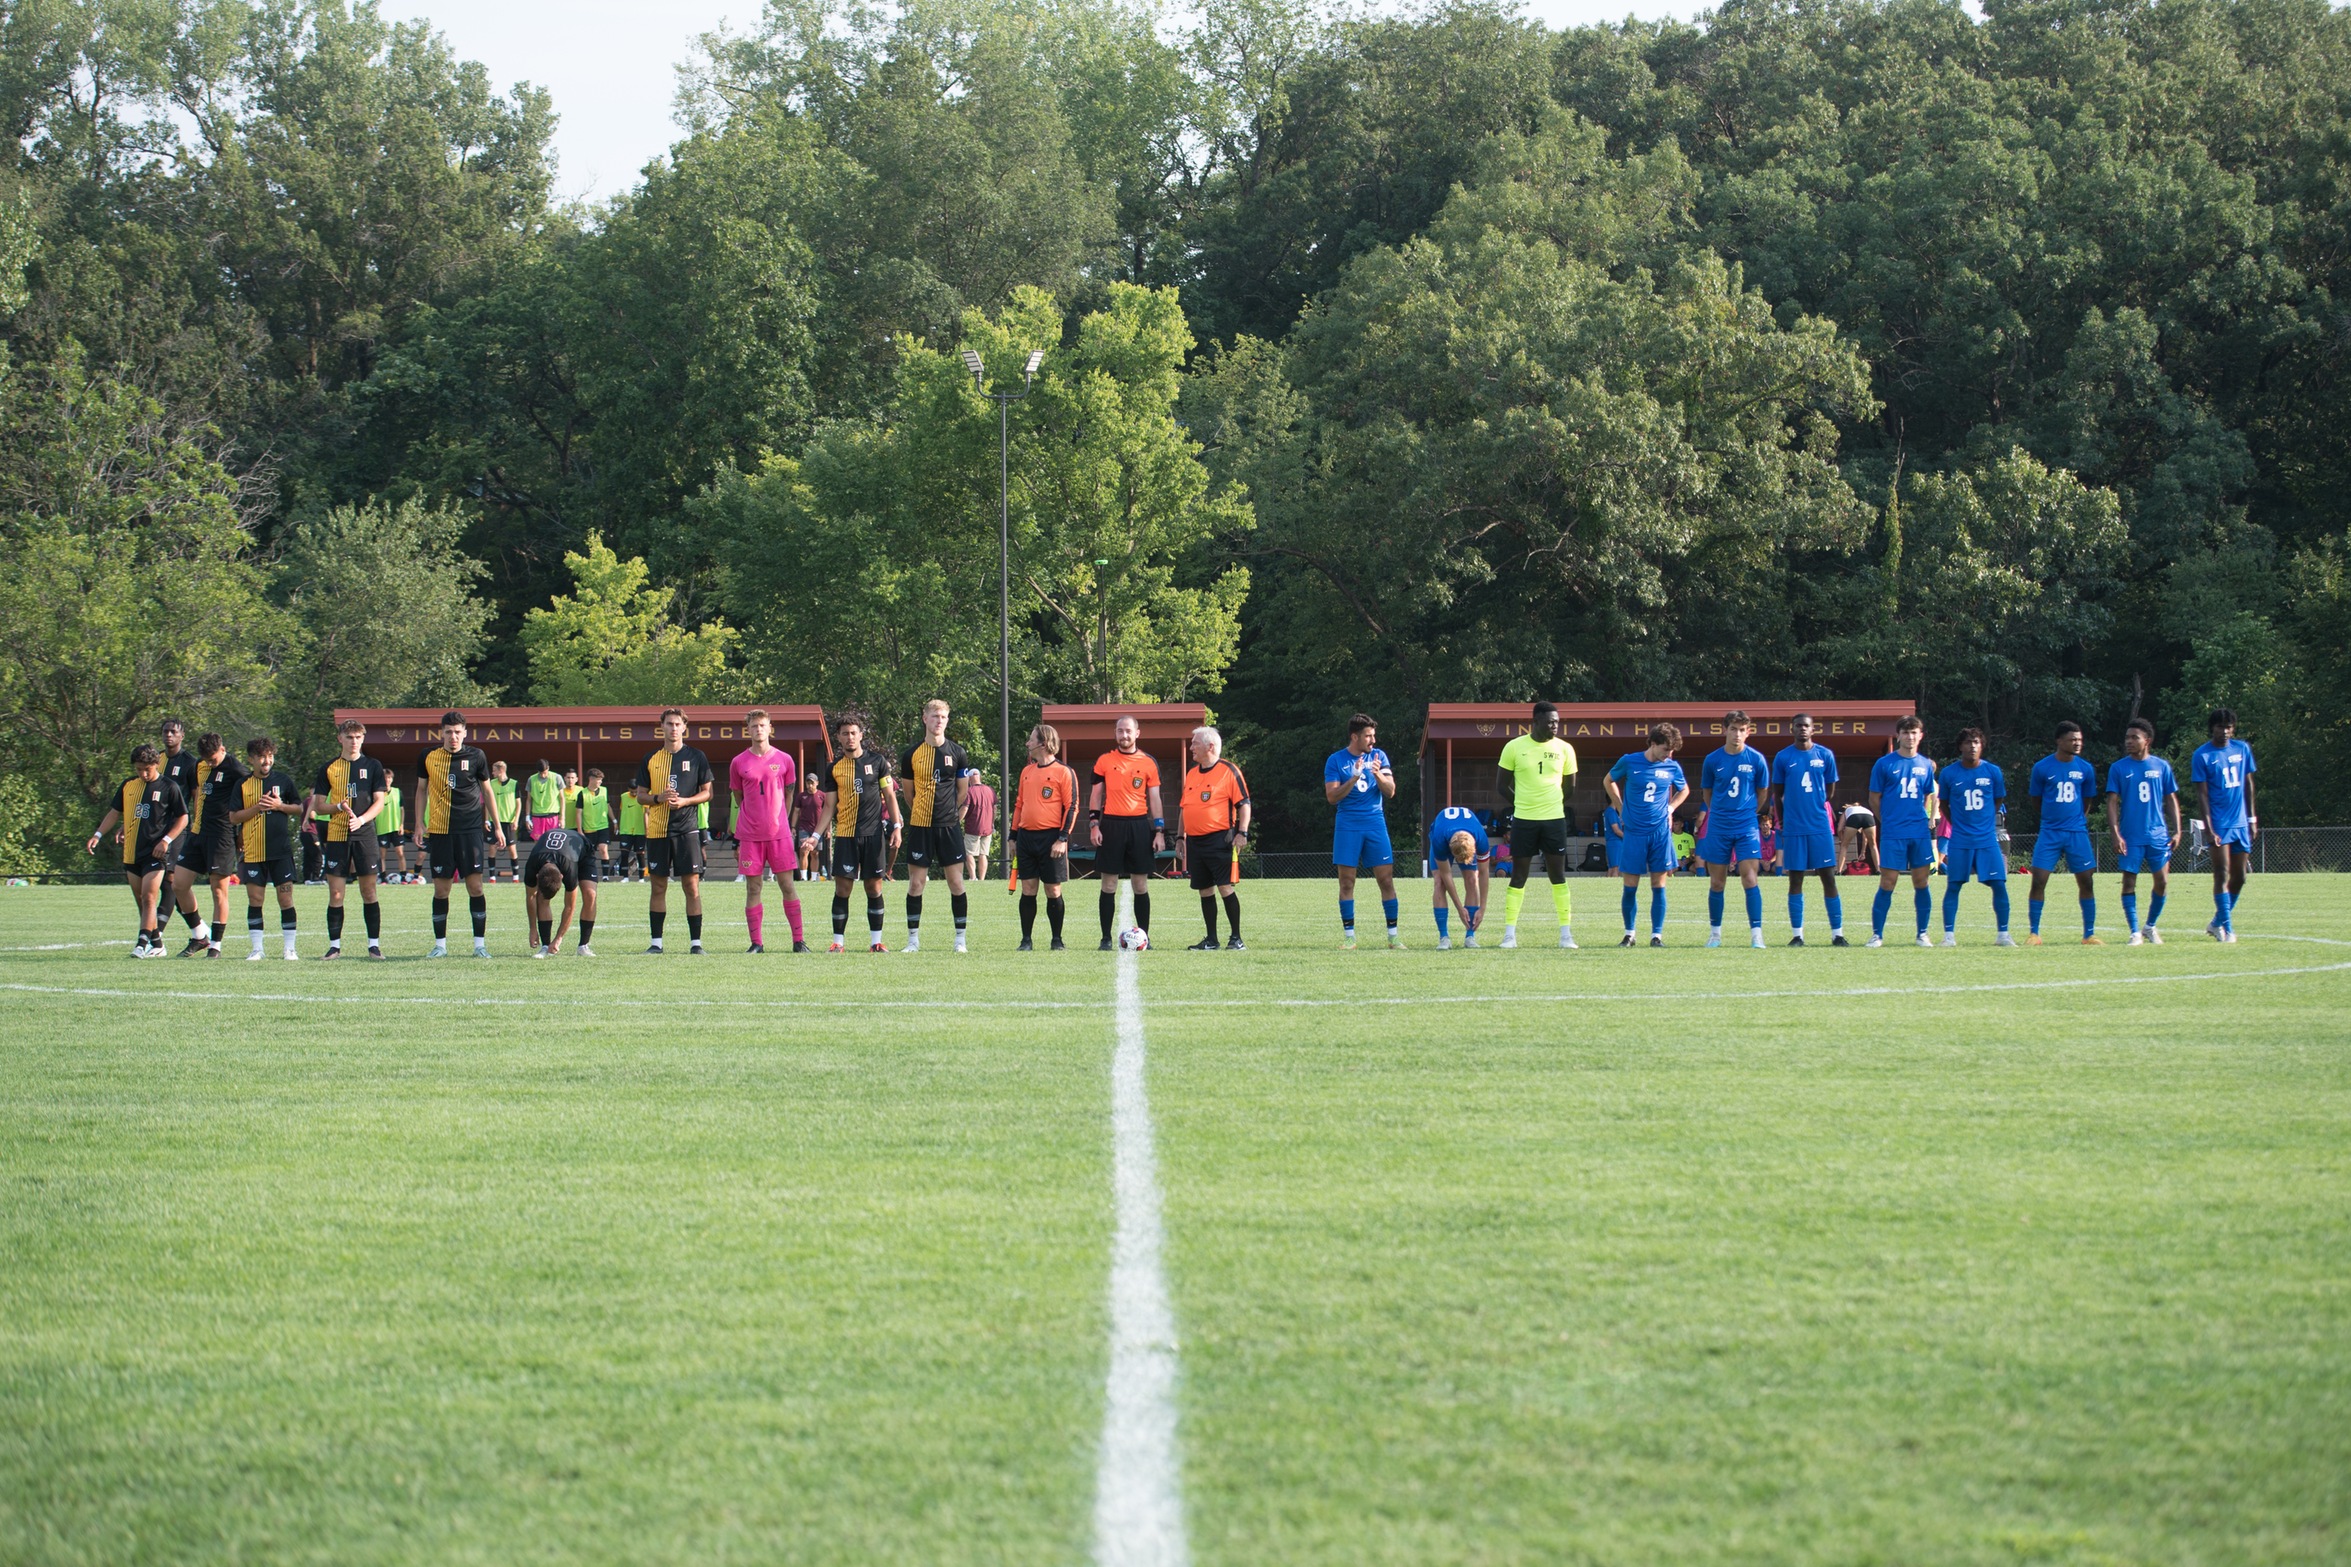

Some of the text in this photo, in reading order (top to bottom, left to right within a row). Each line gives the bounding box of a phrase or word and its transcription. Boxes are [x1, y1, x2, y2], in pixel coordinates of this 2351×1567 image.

[416, 728, 523, 740] INIAN
[544, 728, 632, 740] HILLS
[1506, 722, 1866, 736] INIAN HLS SOCER
[932, 768, 940, 784] 4
[1538, 761, 1543, 774] 1
[2222, 766, 2240, 788] 11
[347, 782, 358, 798] 11
[448, 773, 456, 790] 9
[760, 781, 764, 796] 1
[854, 778, 864, 794] 2
[1356, 772, 1368, 792] 6
[1728, 776, 1740, 798] 3
[1801, 771, 1812, 793] 4
[1900, 776, 1918, 799] 14
[1644, 782, 1656, 802] 2
[1964, 789, 1984, 811] 16
[2055, 781, 2075, 803] 18
[2138, 781, 2151, 803] 8
[546, 831, 568, 850] 8
